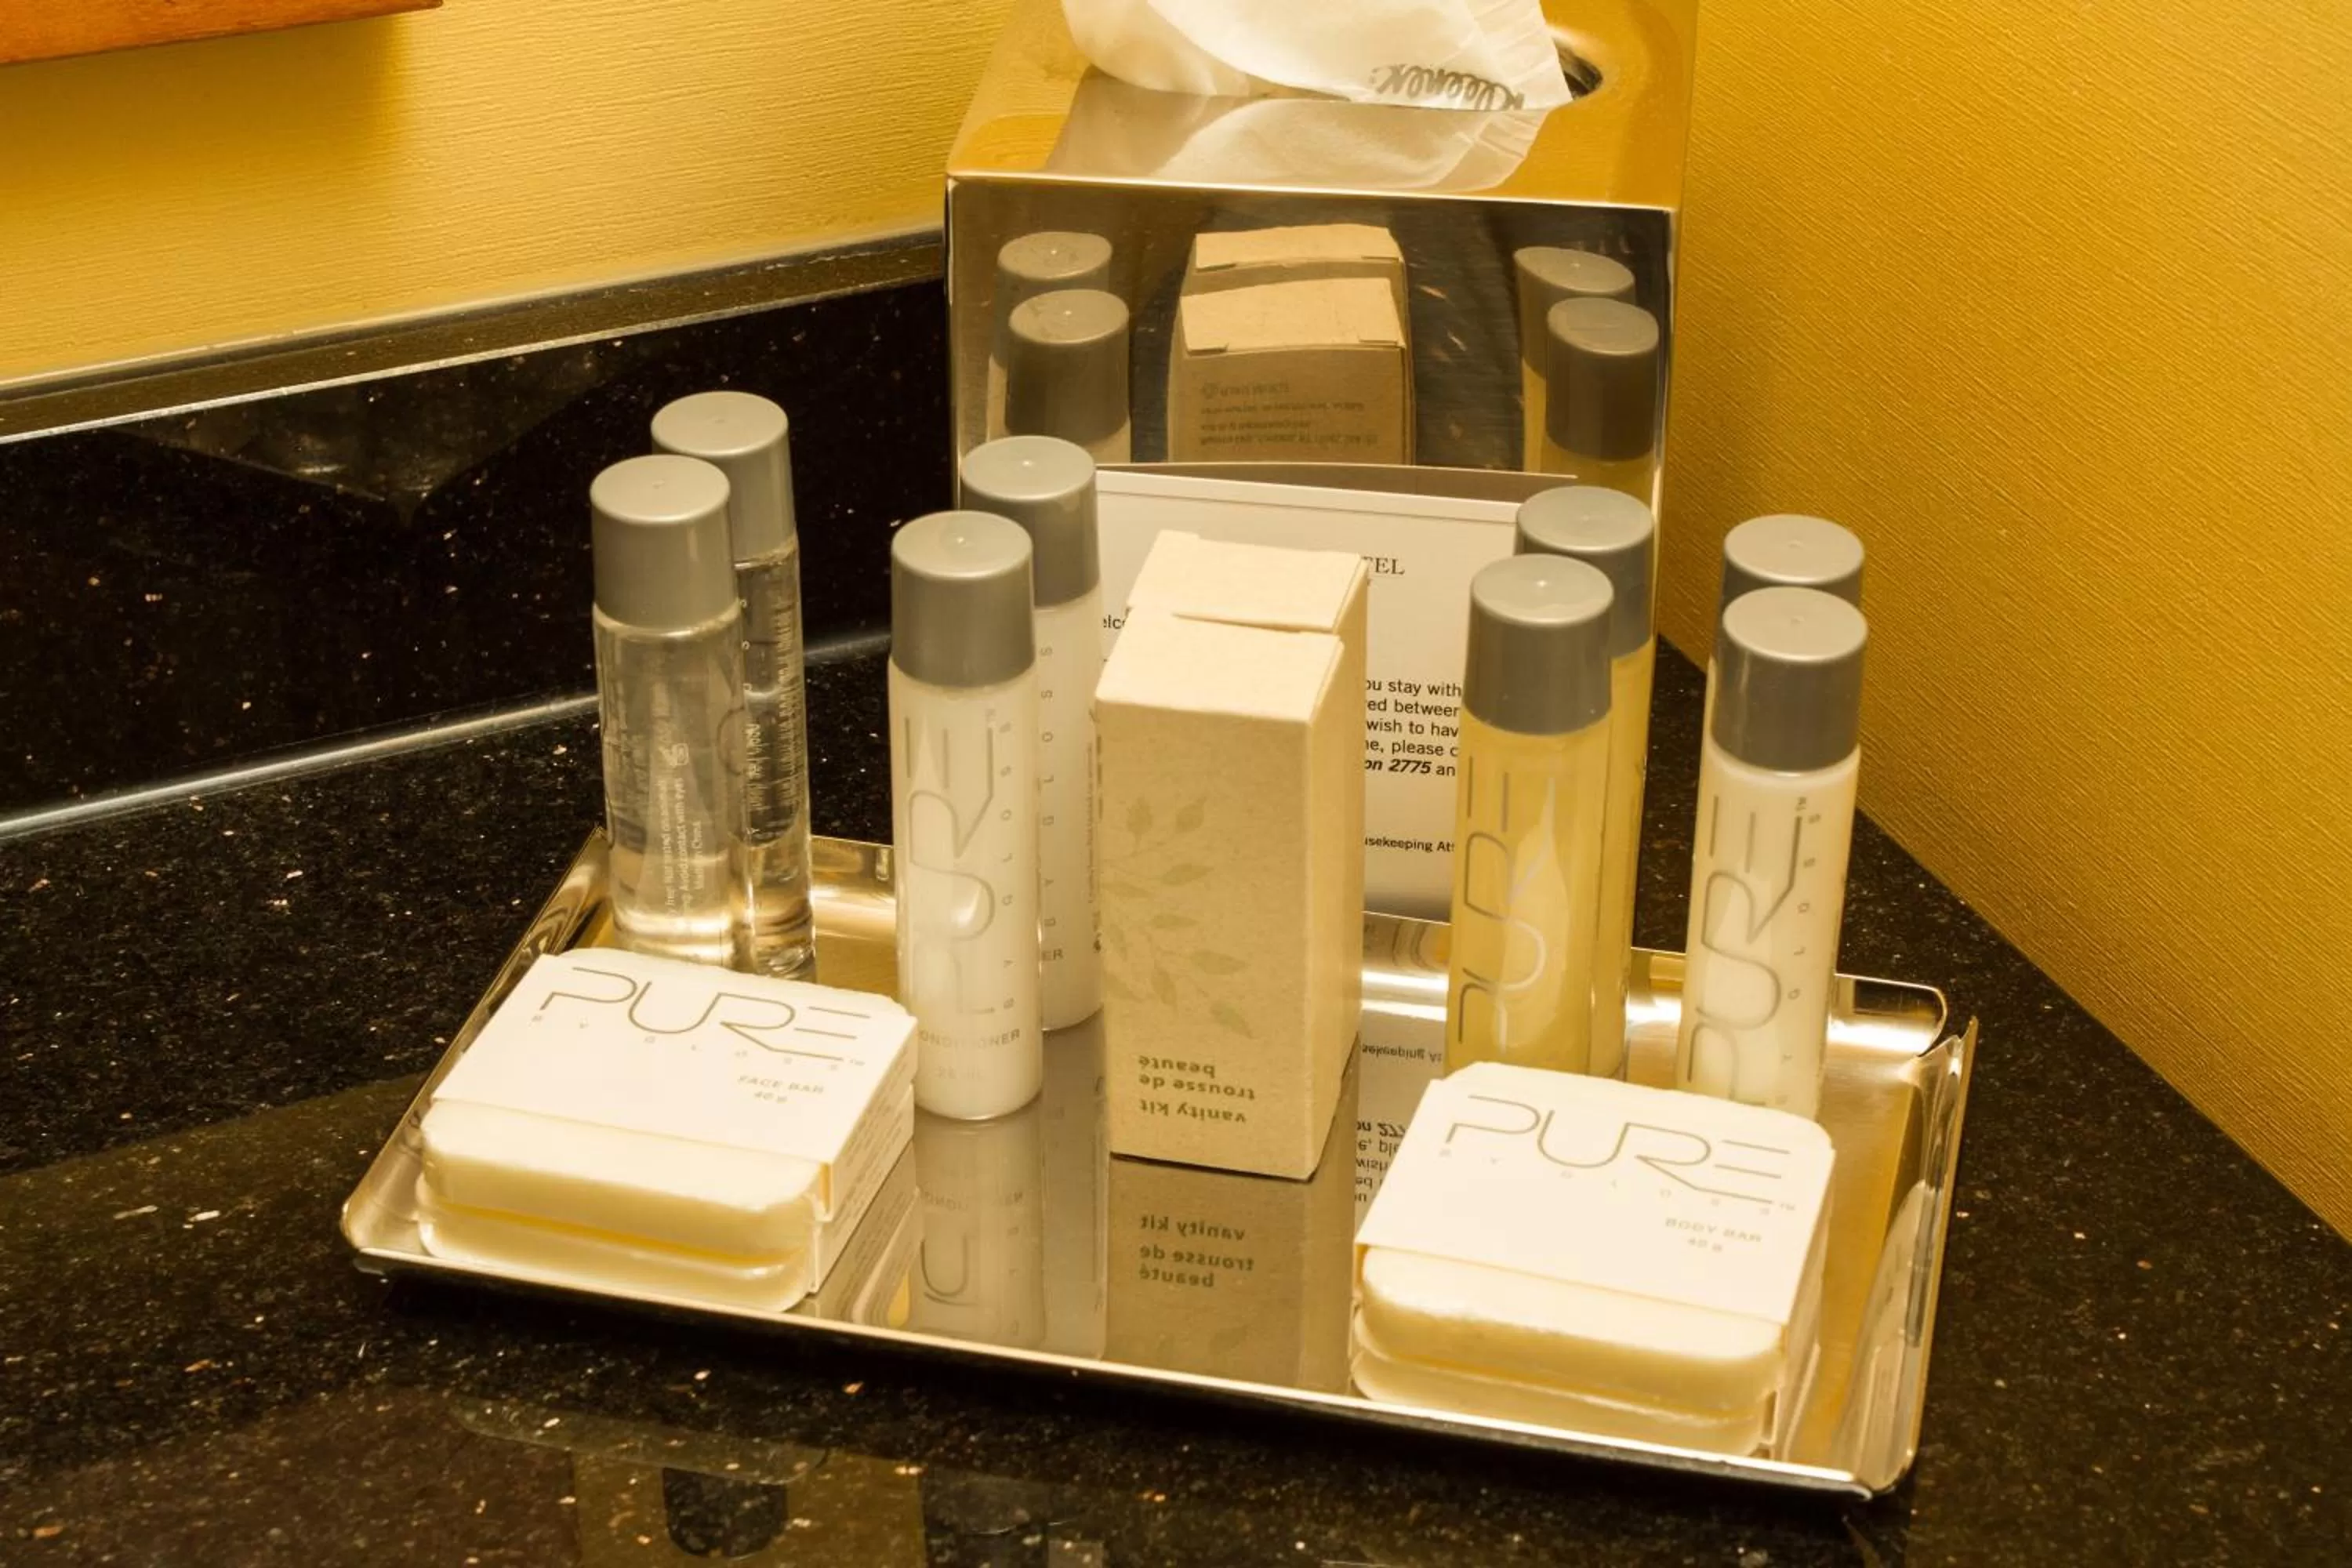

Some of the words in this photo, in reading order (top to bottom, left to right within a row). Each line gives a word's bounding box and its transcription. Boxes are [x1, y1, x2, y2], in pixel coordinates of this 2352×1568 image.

[1388, 680, 1421, 696] stay
[1427, 682, 1461, 697] with
[1367, 718, 1402, 733] wish
[1408, 720, 1425, 735] to
[1431, 722, 1458, 737] hav
[1392, 739, 1443, 756] please
[1388, 759, 1432, 774] 2775
[1436, 764, 1456, 776] an
[539, 967, 872, 1062] PURE
[1138, 1055, 1216, 1080] beauté
[1138, 1073, 1166, 1091] de
[1172, 1079, 1256, 1102] trousse
[1138, 1098, 1170, 1117] kit
[1176, 1102, 1247, 1125] vanity
[1445, 1094, 1791, 1204] PURE
[1664, 1216, 1718, 1234] BODY
